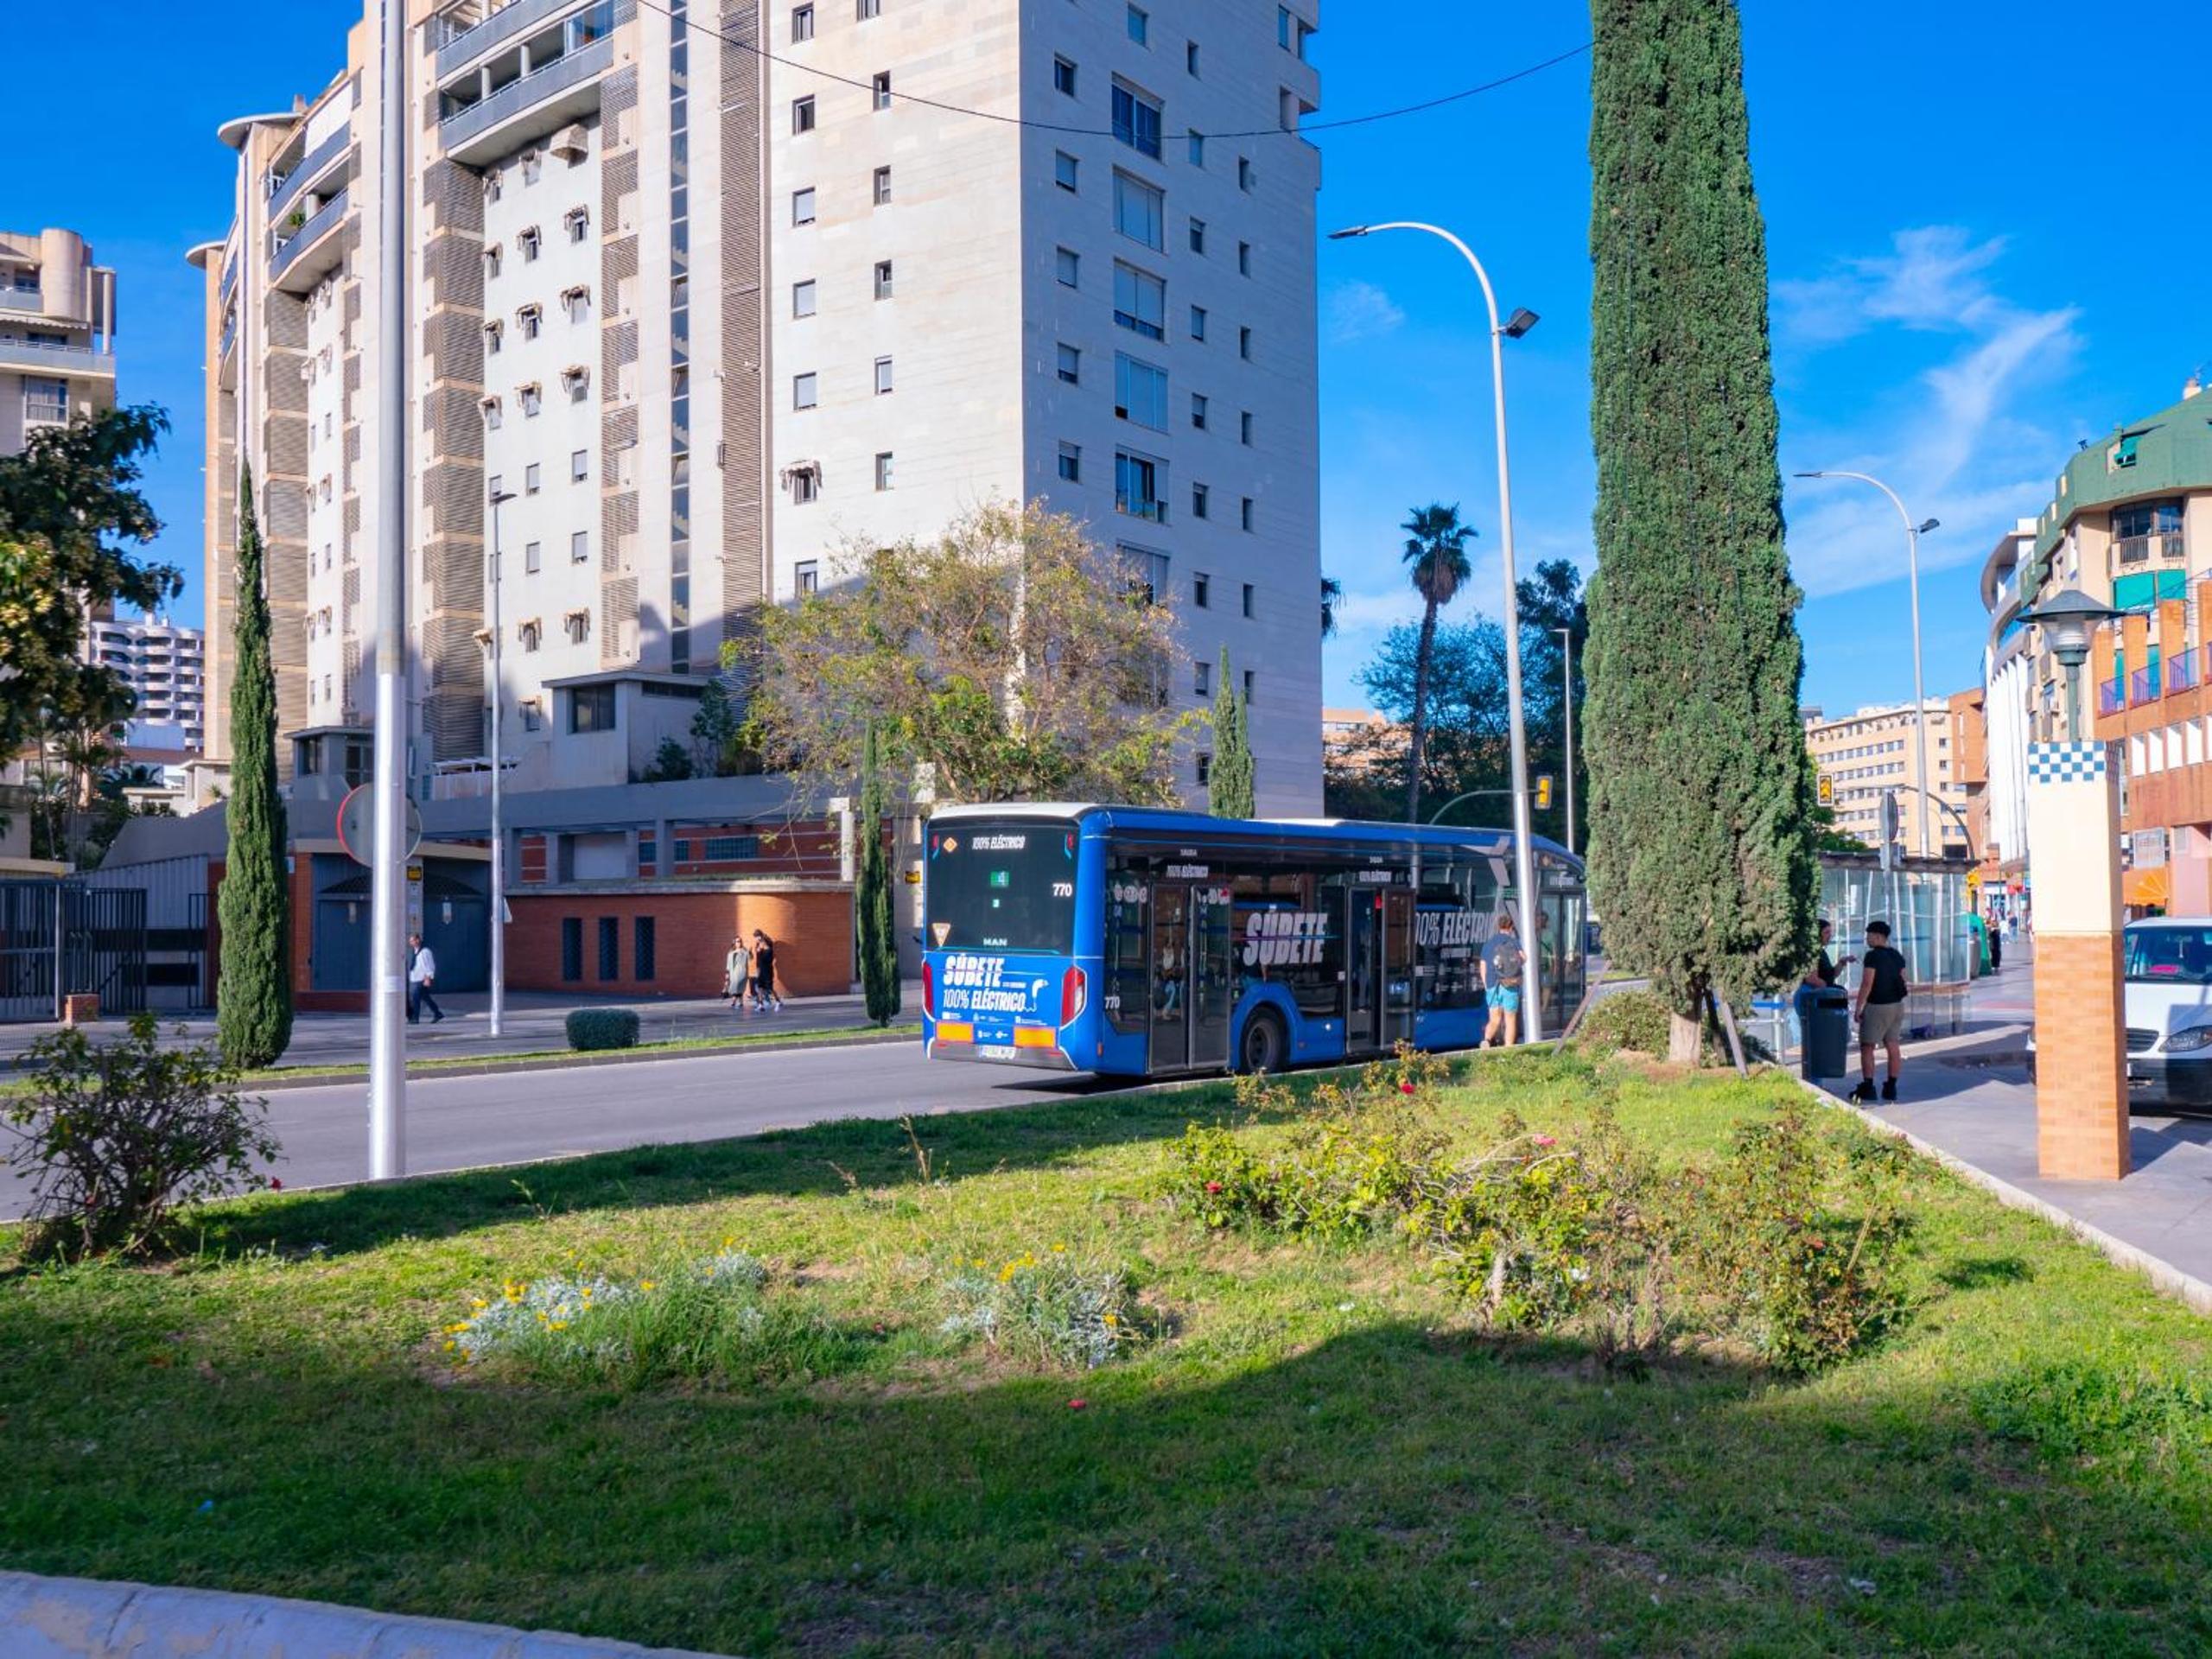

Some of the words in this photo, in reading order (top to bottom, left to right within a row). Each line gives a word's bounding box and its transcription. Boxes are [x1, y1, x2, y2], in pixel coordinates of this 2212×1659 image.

[972, 836, 989, 850] 100%
[990, 835, 1026, 849] ELÉCTRICO
[1052, 882, 1073, 897] 770
[983, 938, 1008, 947] MAN
[1243, 904, 1328, 966] SÚBETE
[943, 952, 1005, 988] SÚBETE
[943, 988, 970, 1009] 100%
[970, 987, 1027, 1012] ELÉCTRICO
[1104, 995, 1121, 1010] 770
